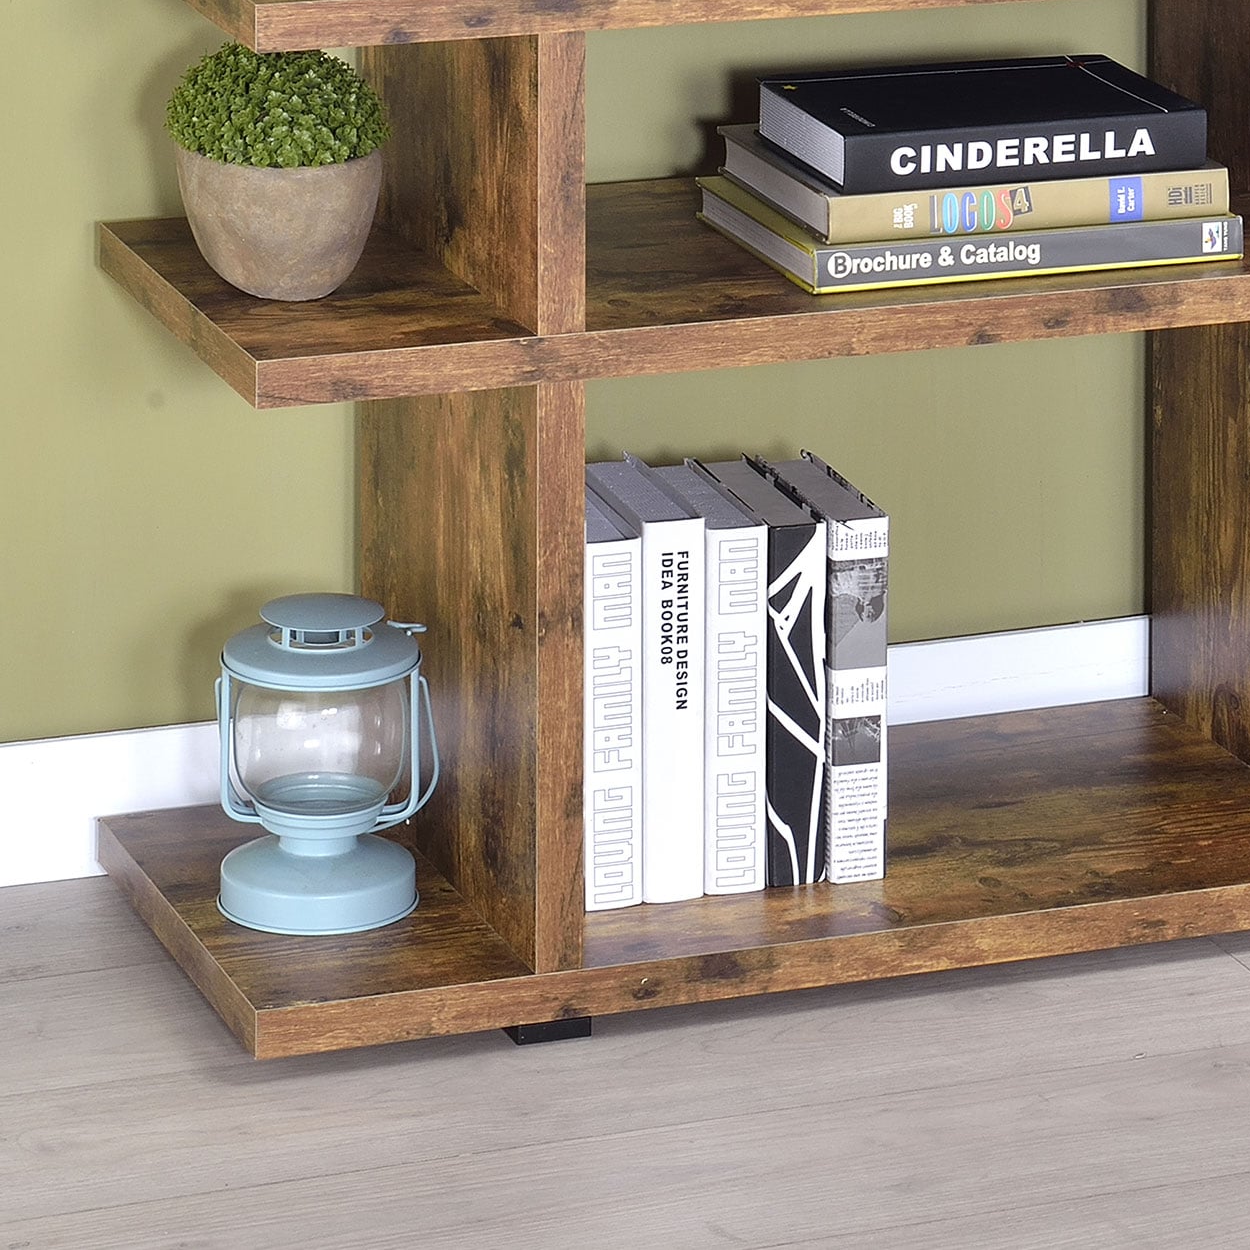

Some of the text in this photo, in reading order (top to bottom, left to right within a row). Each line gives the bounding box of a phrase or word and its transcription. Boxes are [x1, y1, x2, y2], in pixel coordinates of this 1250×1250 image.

[890, 128, 1155, 175] CINDERELLA
[827, 241, 1040, 278] Brochure & Catalog
[929, 189, 1013, 234] LOGOS
[660, 552, 674, 665] IDEA BOOK08
[676, 551, 689, 710] FURNITURE DESIGN
[593, 552, 634, 904] LOVING FAMILY MAN
[715, 537, 758, 888] LOVING FAMILY MAN
